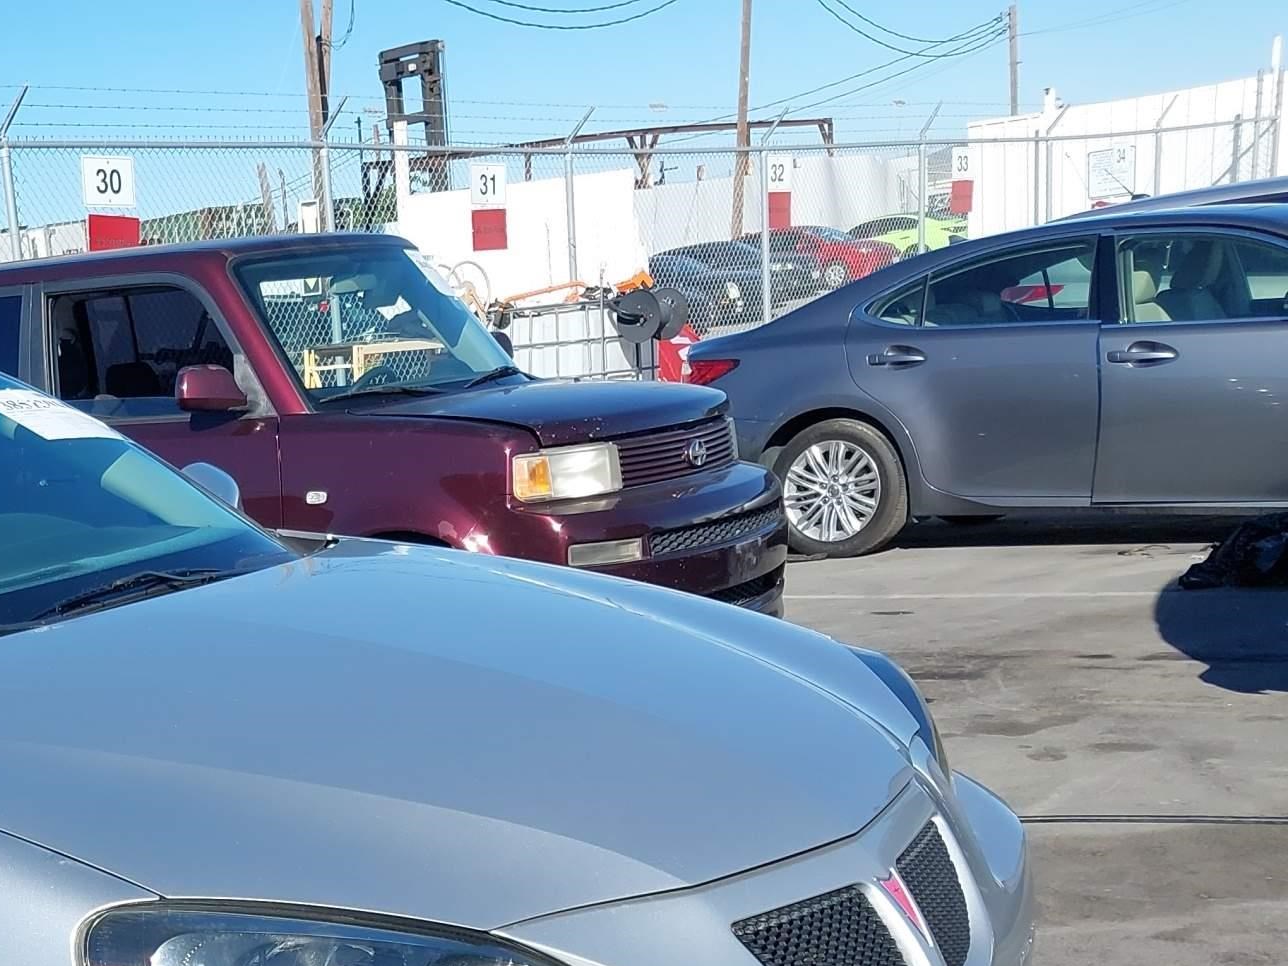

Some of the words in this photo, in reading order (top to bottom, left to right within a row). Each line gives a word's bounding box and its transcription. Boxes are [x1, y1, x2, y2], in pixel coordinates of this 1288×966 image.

[770, 163, 785, 182] 32
[957, 155, 969, 172] 33
[96, 168, 122, 194] 30
[479, 174, 496, 195] 31
